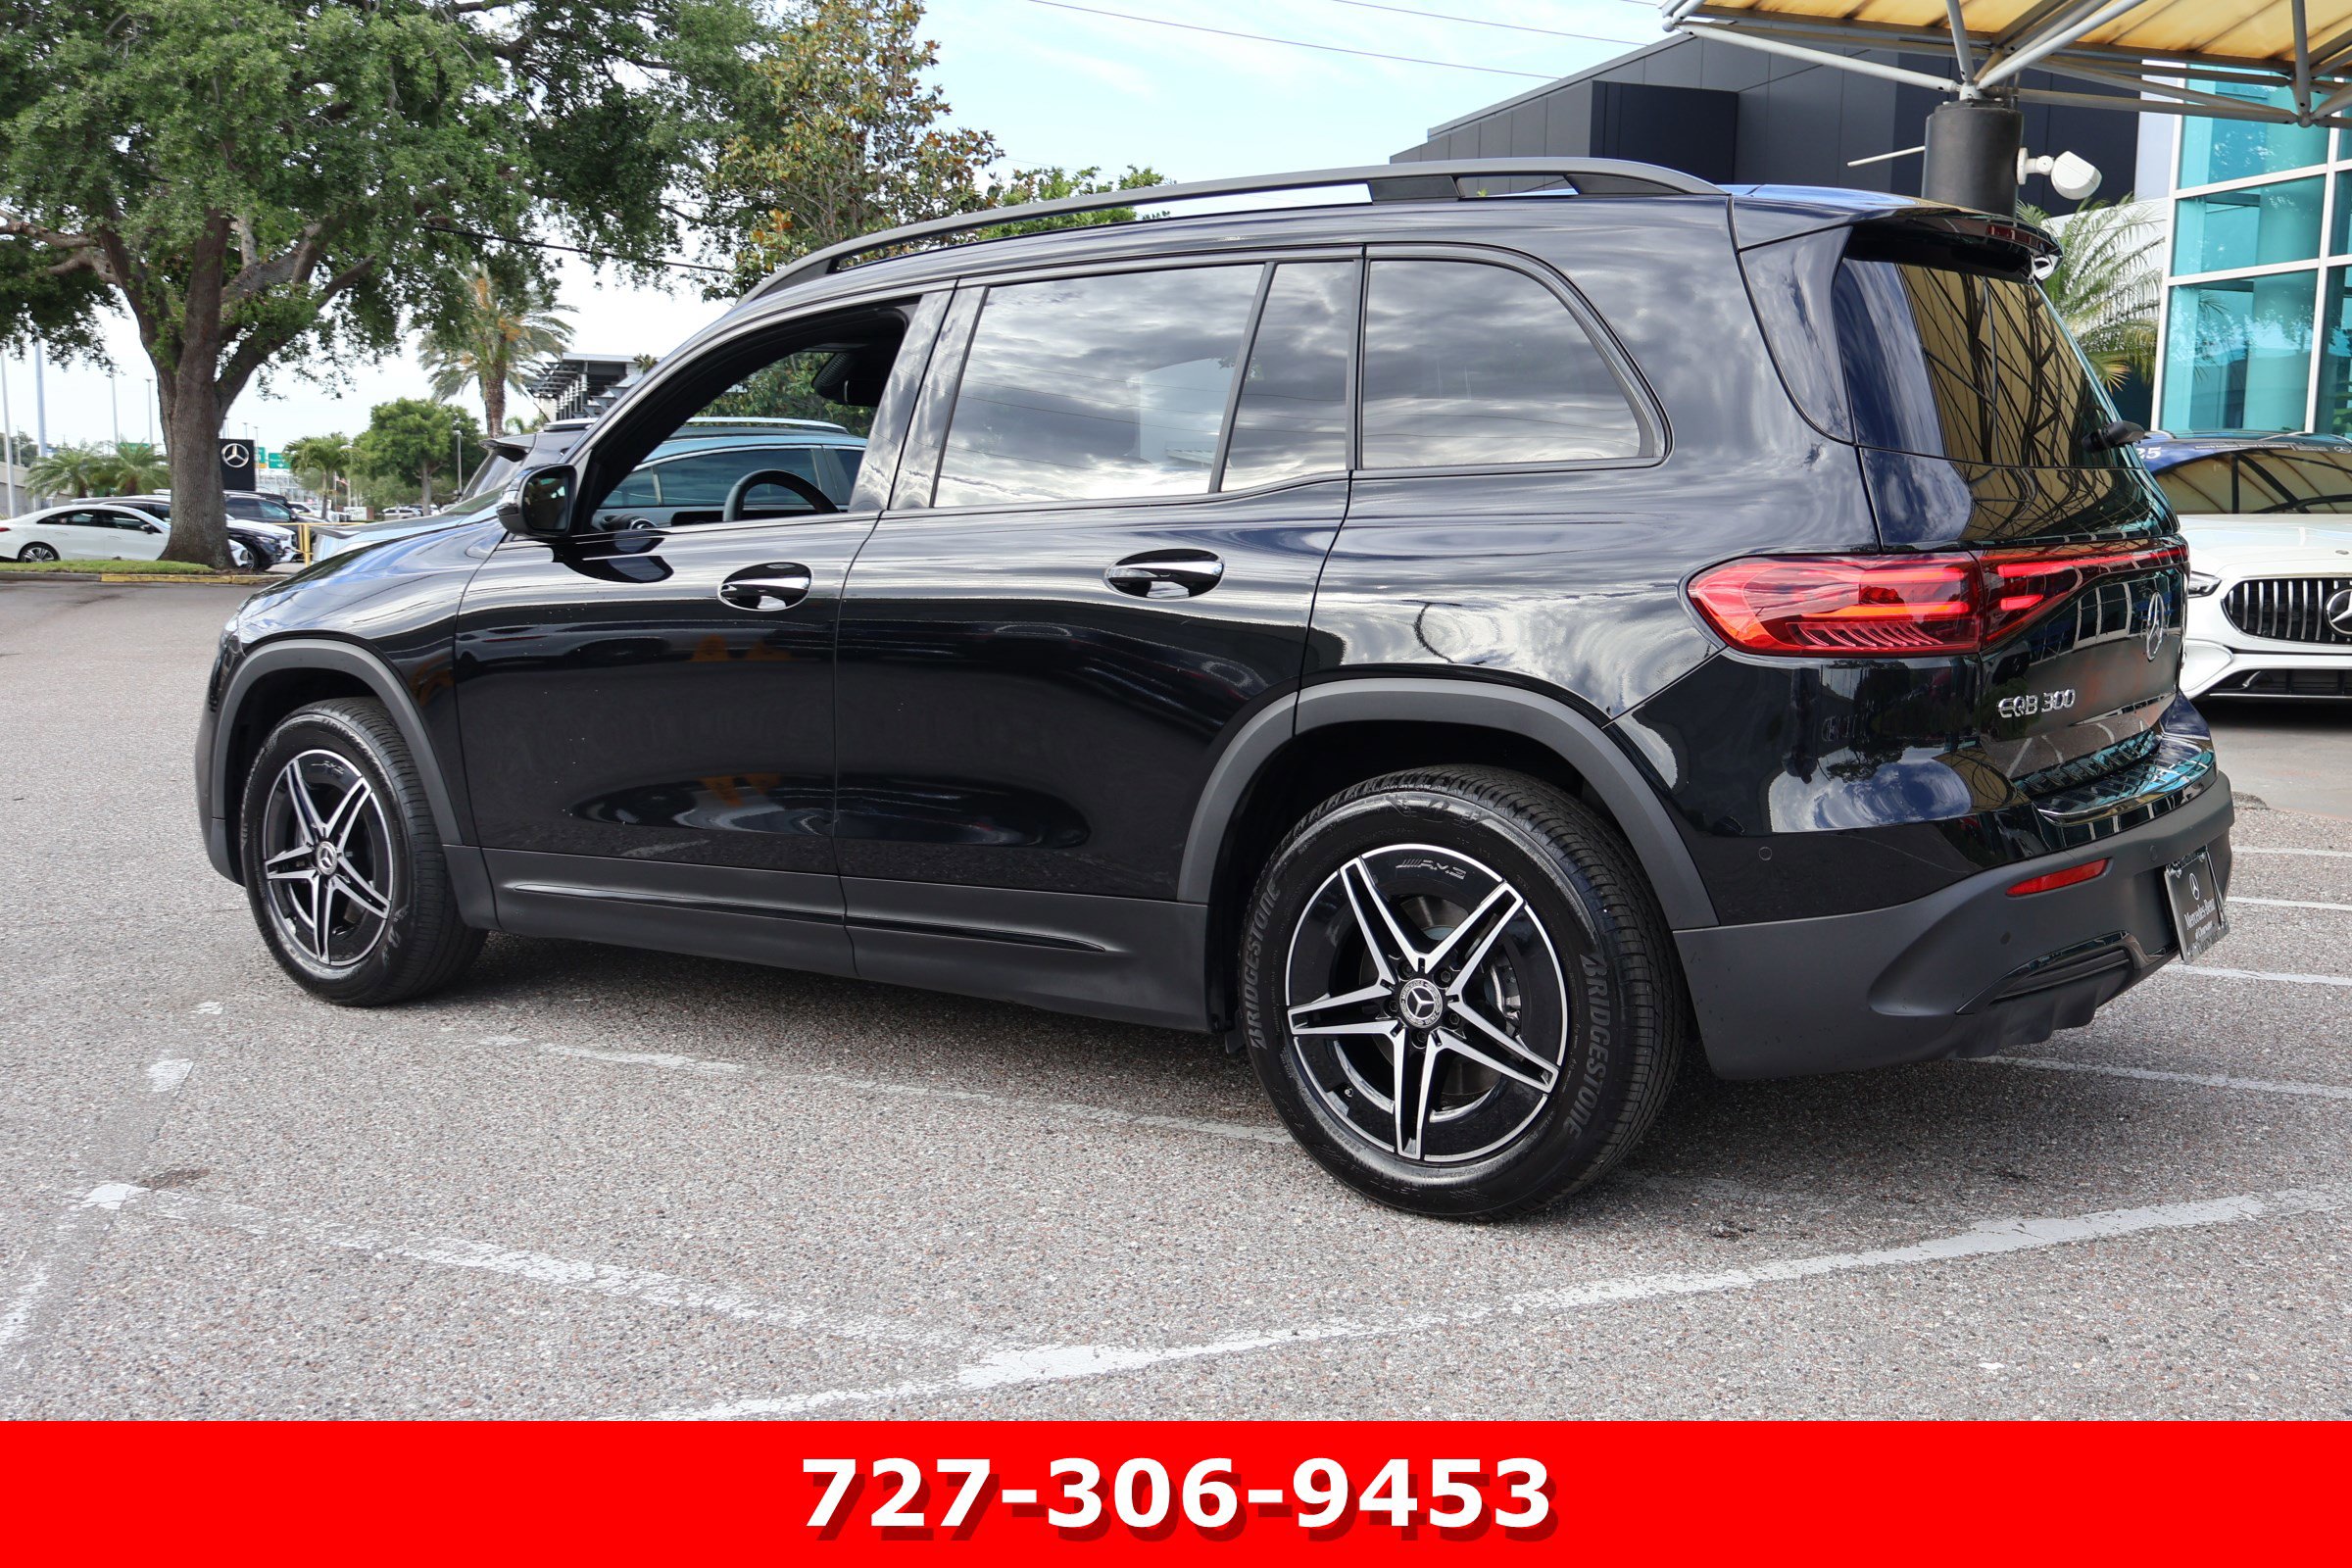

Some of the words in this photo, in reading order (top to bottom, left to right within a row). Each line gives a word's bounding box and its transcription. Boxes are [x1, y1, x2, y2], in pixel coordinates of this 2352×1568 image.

[1997, 696, 2038, 718] EQB
[2041, 689, 2076, 712] 300
[1244, 878, 1281, 1050] BRIDGESTONE
[2184, 899, 2217, 930] Mercedes-Benz
[1563, 954, 1610, 1140] BRIDGESTONE
